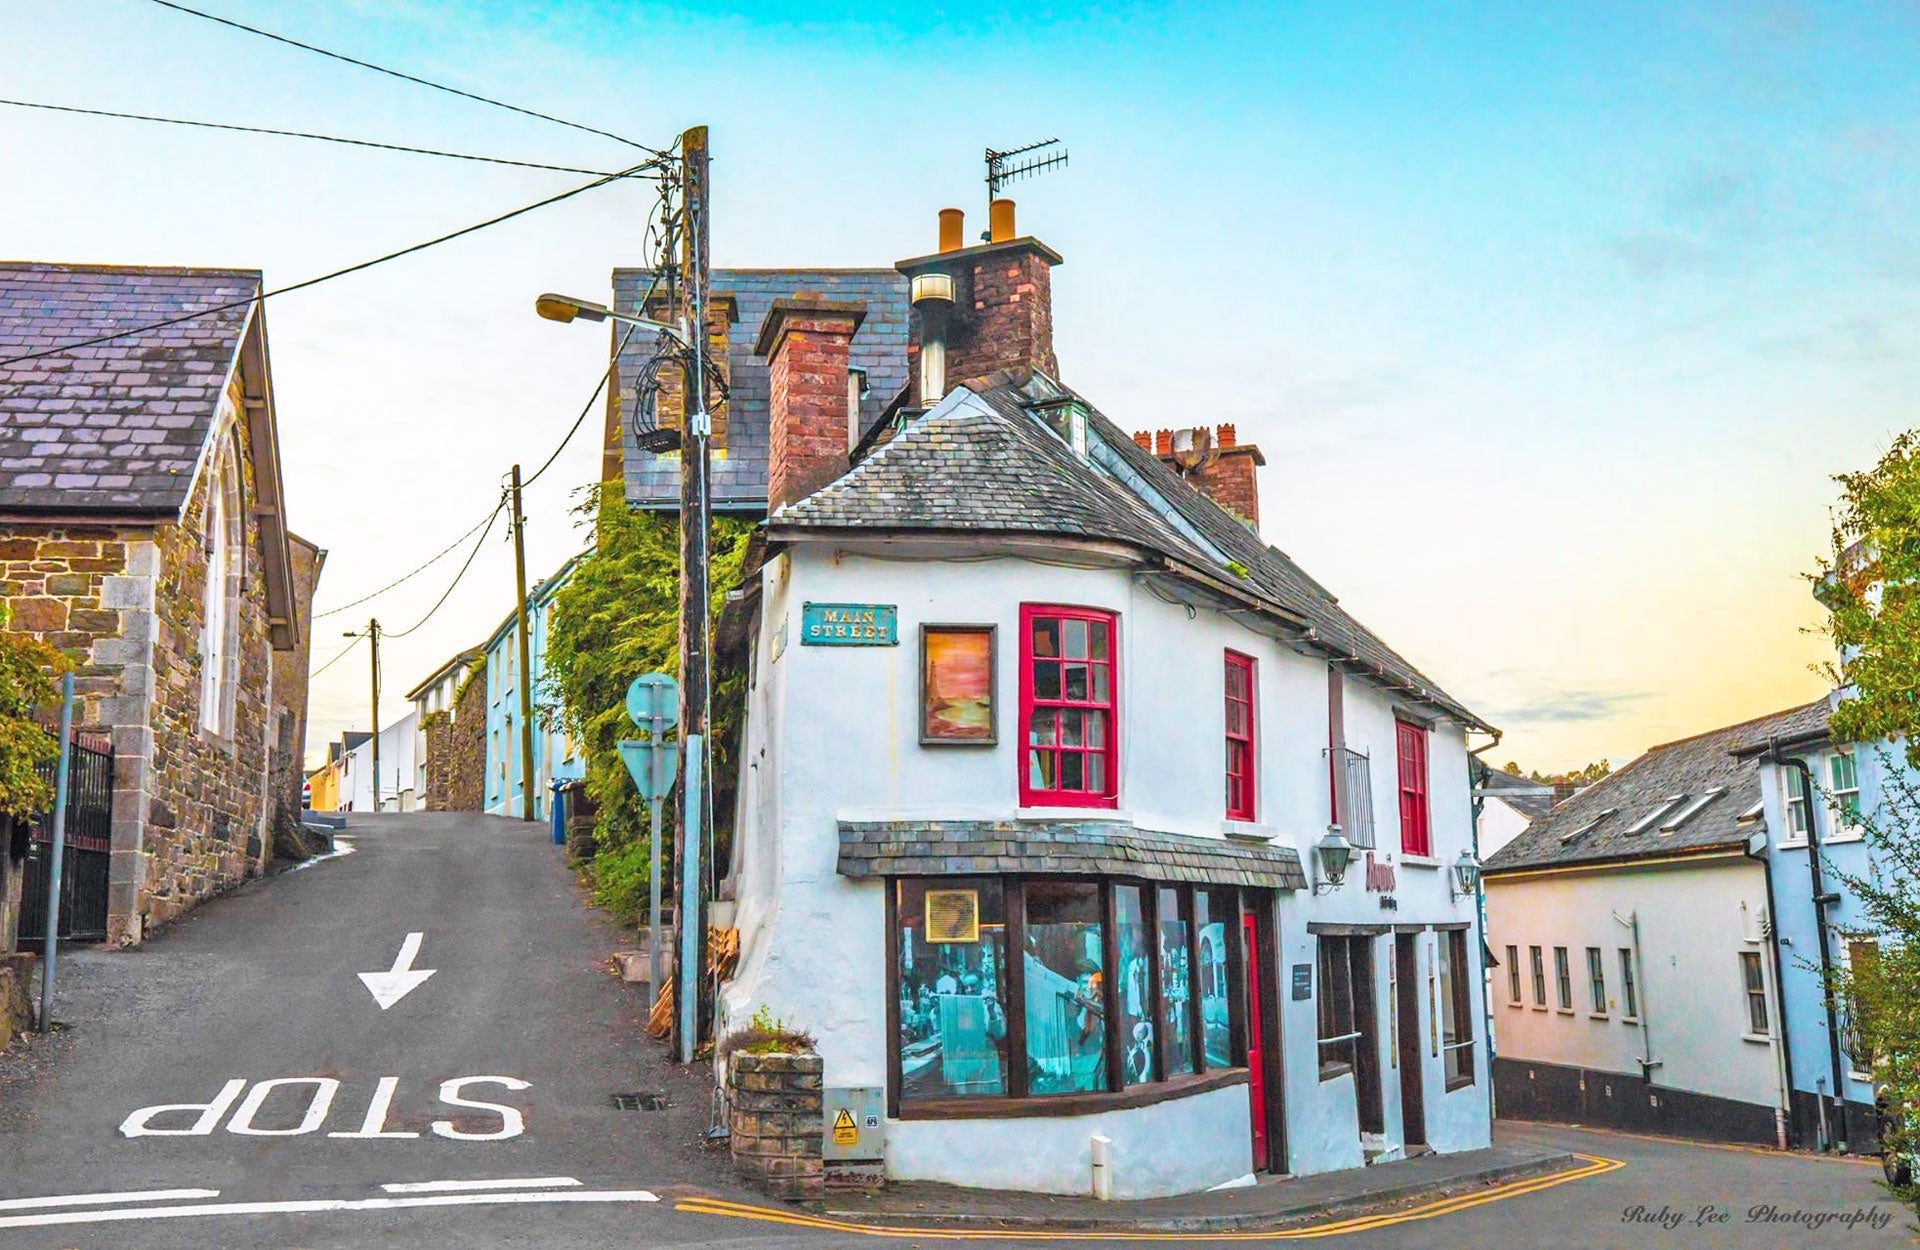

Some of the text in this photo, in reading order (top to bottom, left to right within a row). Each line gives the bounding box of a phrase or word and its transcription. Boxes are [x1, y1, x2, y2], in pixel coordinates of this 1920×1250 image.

[824, 610, 875, 623] MAIN
[811, 626, 888, 638] STREET
[119, 1076, 533, 1140] STOP
